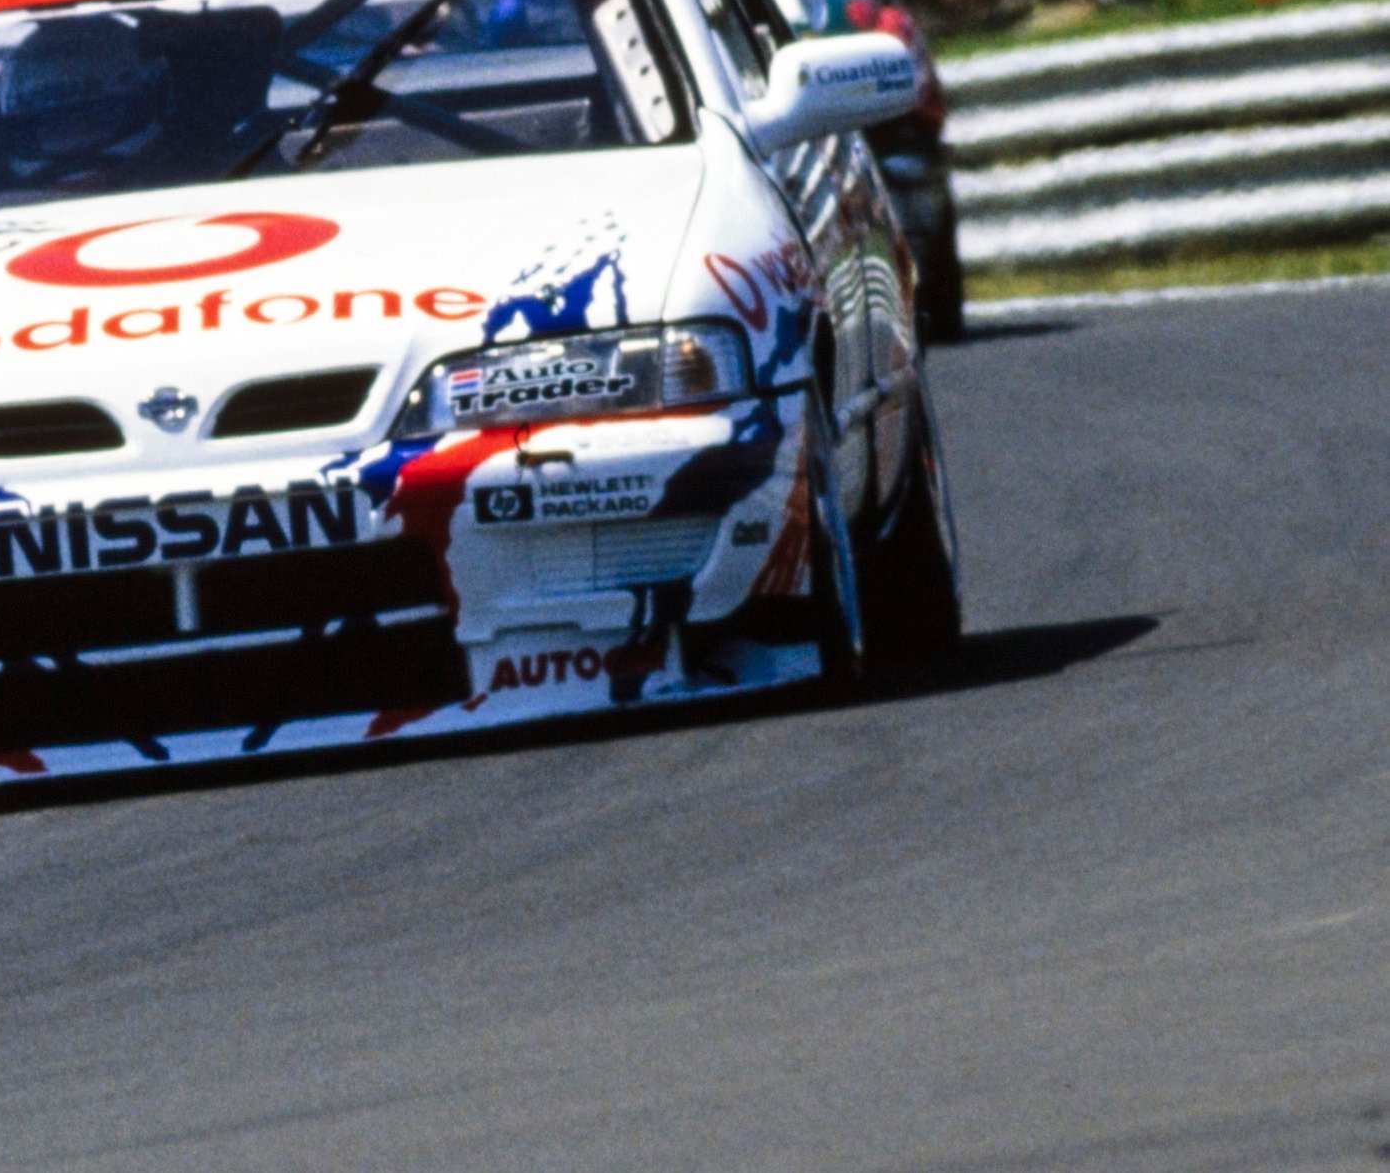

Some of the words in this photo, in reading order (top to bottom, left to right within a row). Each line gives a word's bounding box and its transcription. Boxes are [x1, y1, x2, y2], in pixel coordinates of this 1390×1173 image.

[484, 360, 597, 386] Auto
[450, 376, 635, 412] Trader
[540, 474, 649, 496] HEWLETT
[541, 494, 651, 518] PACKARD
